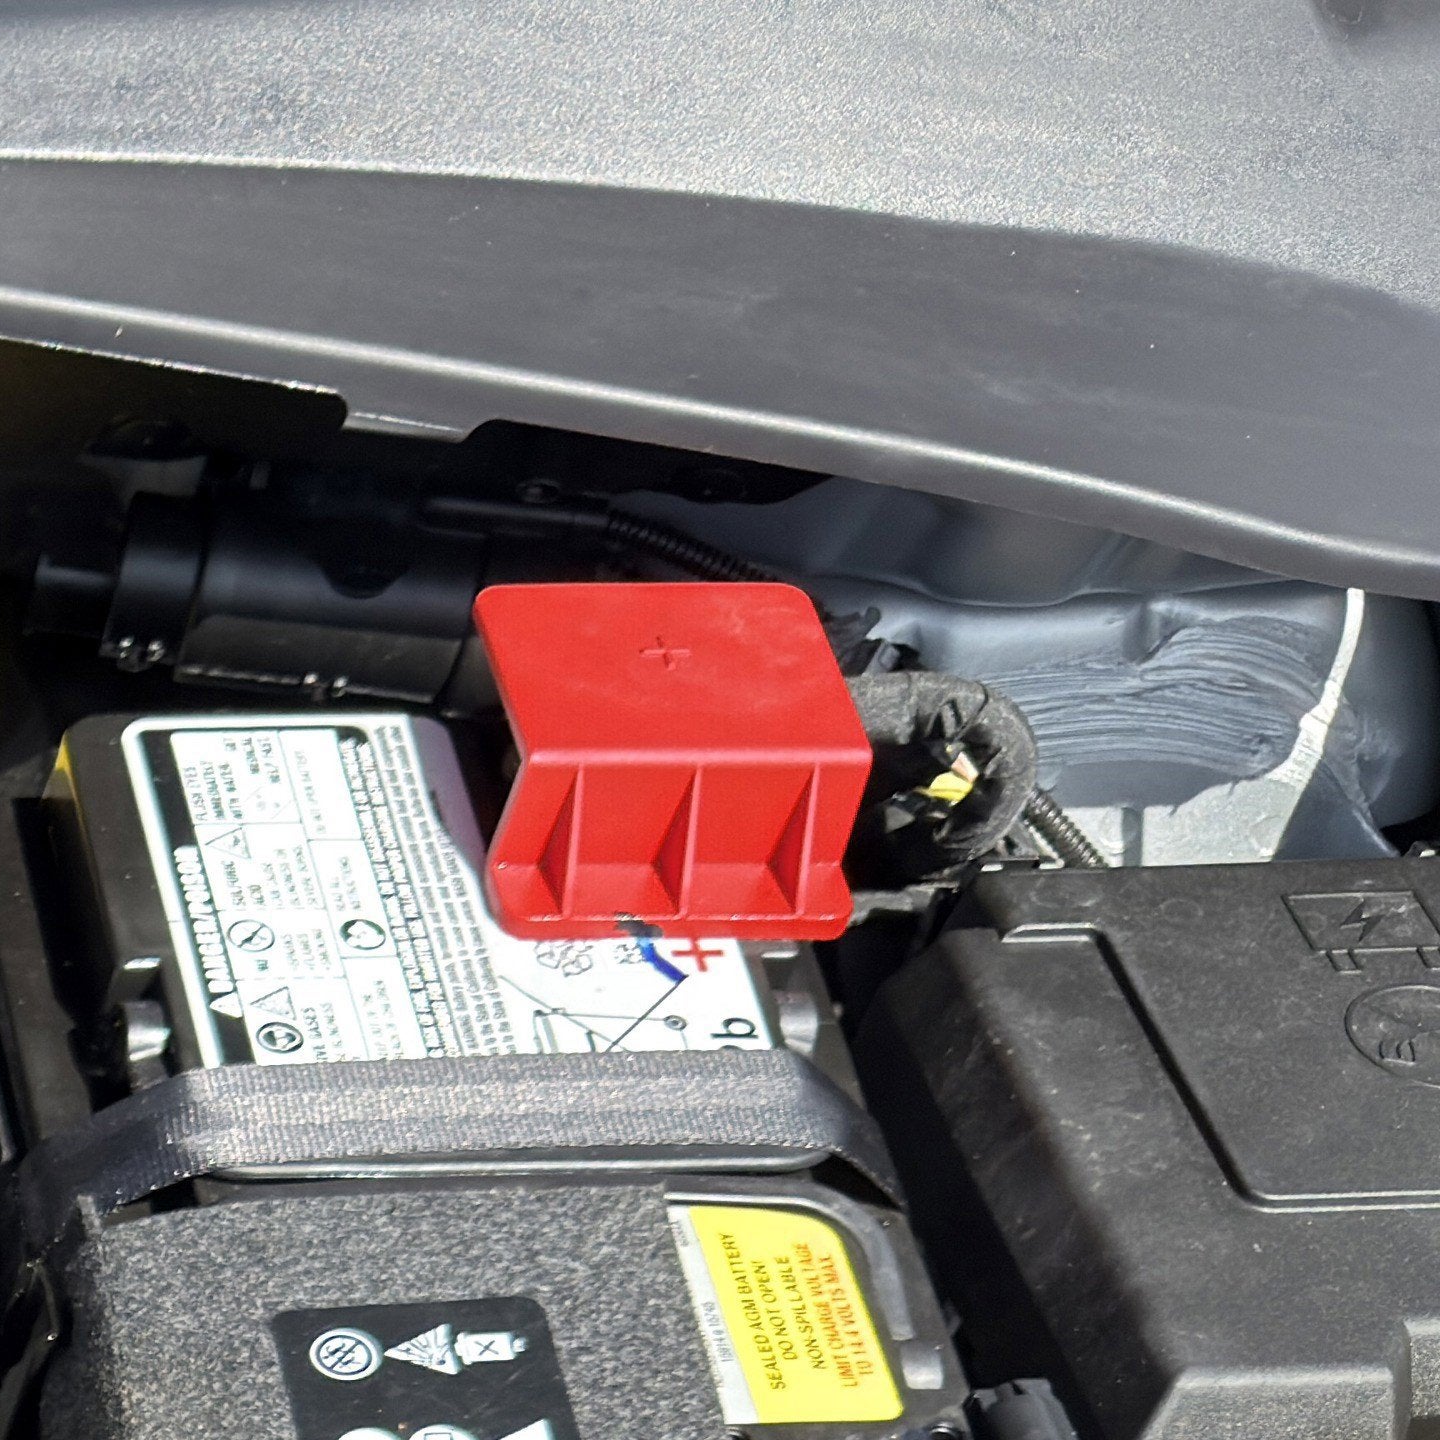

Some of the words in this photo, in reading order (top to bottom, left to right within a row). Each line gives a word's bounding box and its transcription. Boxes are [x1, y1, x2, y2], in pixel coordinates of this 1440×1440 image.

[173, 846, 234, 992] DANGER/POISON
[719, 1232, 752, 1294] BATTERY
[740, 1299, 764, 1330] AGM
[767, 1308, 789, 1336] NOT
[753, 1335, 786, 1389] SEALED
[778, 1341, 798, 1360] DO
